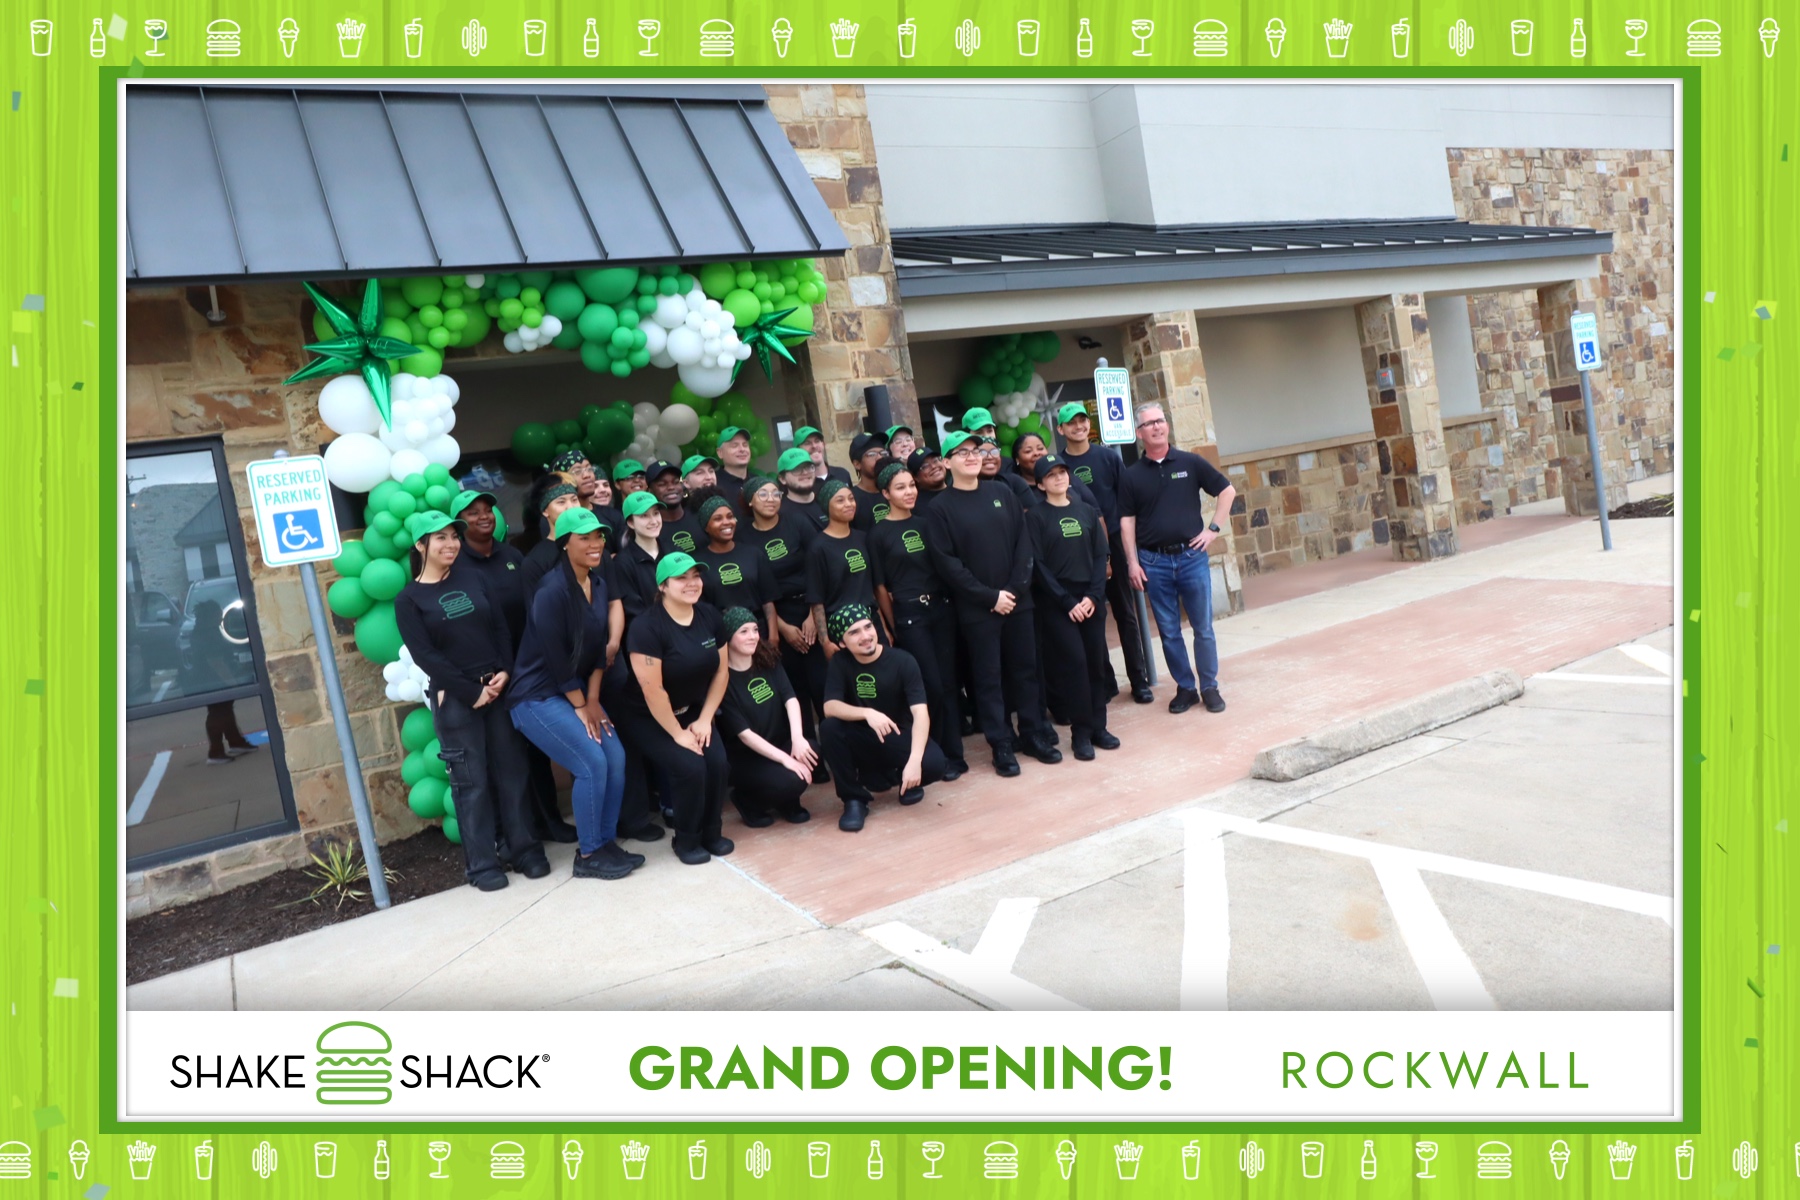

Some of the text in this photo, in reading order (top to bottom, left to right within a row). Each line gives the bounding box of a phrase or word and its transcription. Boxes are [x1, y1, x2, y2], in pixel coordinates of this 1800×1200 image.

[1099, 373, 1126, 384] RESERVED
[1103, 386, 1124, 396] PARKING
[256, 469, 321, 489] RESERVED
[264, 487, 321, 506] PARKING
